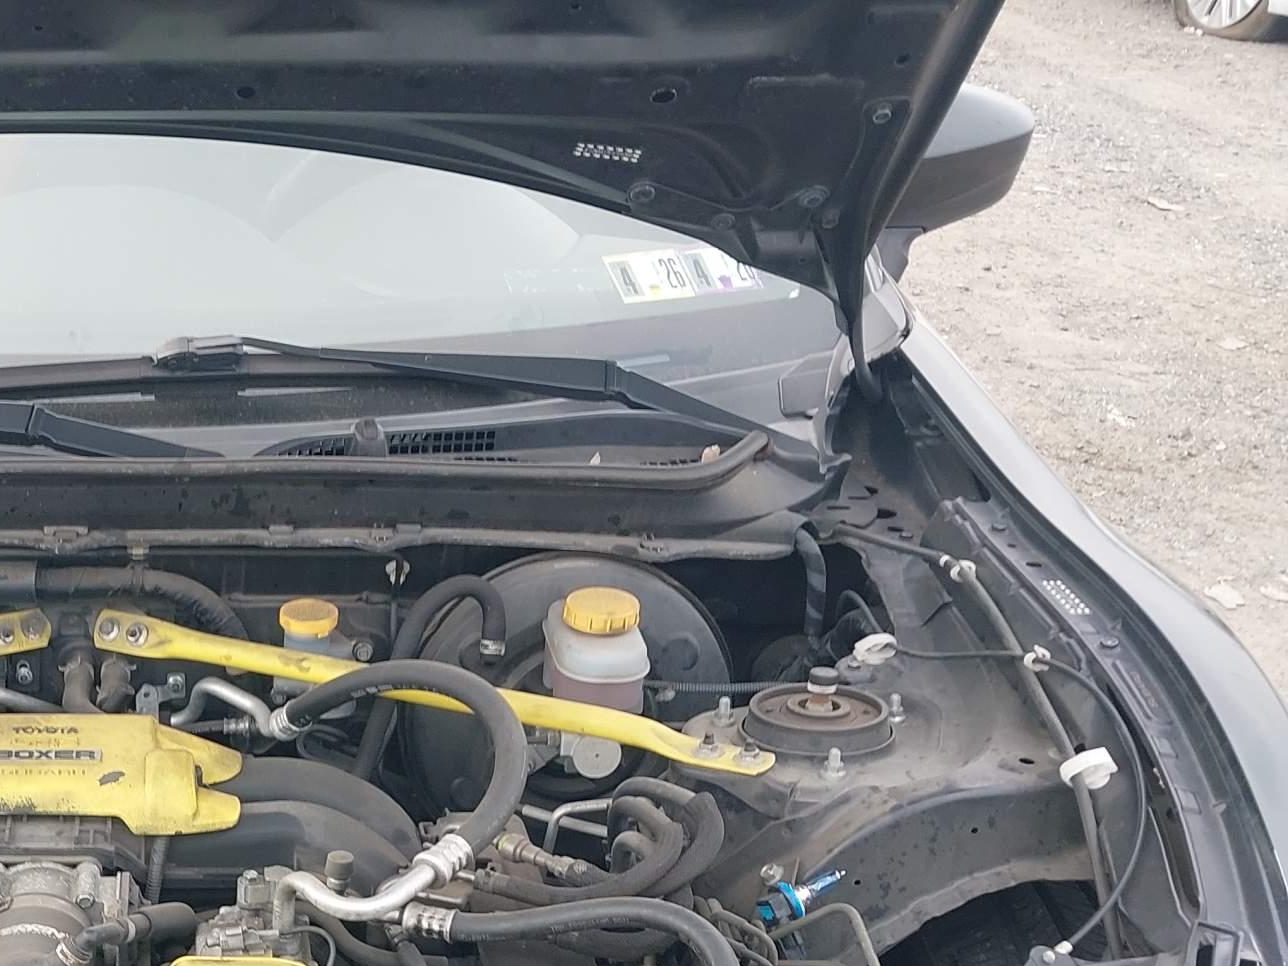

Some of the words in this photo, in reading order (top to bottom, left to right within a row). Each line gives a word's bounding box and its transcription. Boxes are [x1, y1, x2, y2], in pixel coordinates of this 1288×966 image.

[619, 266, 639, 295] 4
[657, 257, 687, 289] 26
[692, 258, 712, 288] 4
[12, 726, 79, 735] TOYOTA
